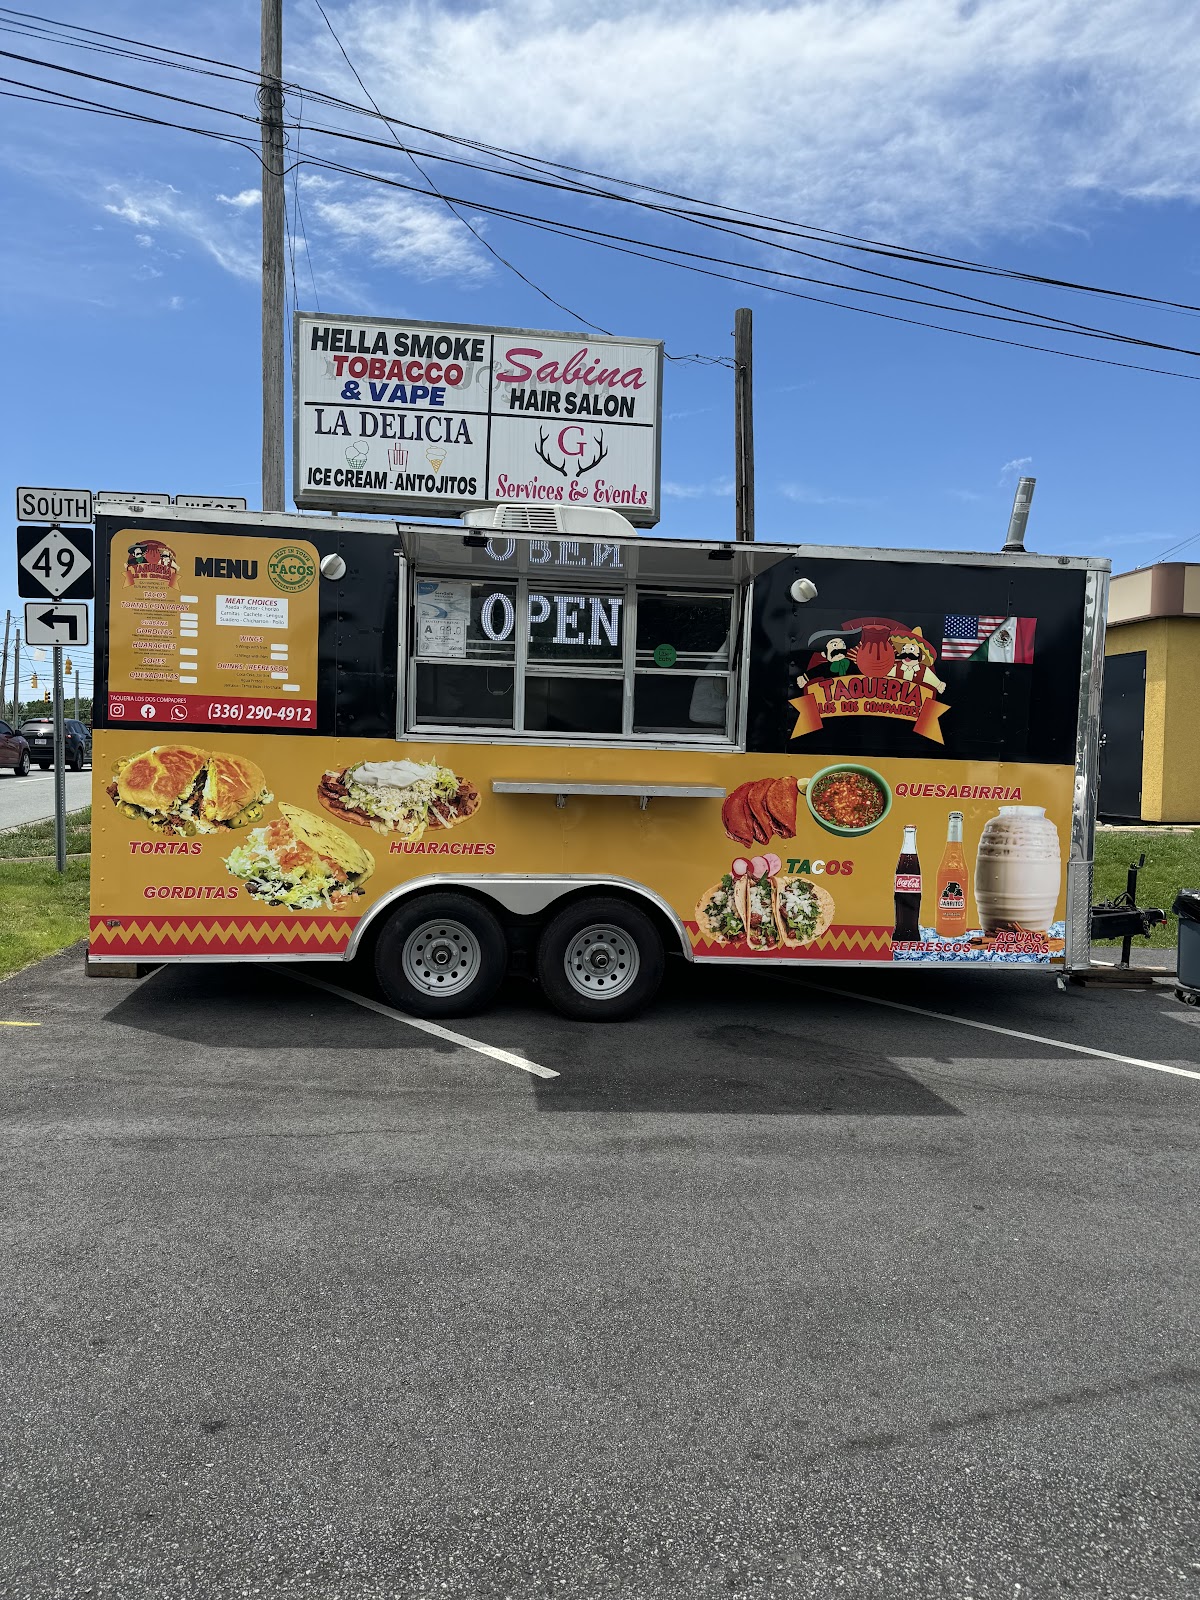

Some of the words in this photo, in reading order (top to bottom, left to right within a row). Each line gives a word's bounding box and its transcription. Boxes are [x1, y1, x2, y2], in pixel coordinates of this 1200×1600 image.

[311, 327, 389, 356] HELLA
[393, 333, 485, 362] SMOKE
[334, 355, 464, 386] TOBACCO
[496, 348, 646, 390] Sabina
[341, 380, 362, 400] &
[369, 382, 446, 406] VAPE
[510, 388, 561, 414] HAIR
[564, 392, 636, 418] SALON
[314, 409, 350, 436] LA
[360, 412, 473, 444] DELICIA
[558, 426, 587, 456] G
[308, 468, 332, 486] ICE
[334, 469, 387, 490] CREAM
[394, 472, 477, 496] ANTOJITOS
[496, 474, 563, 500] Services
[568, 480, 588, 501] &
[593, 480, 648, 505] Events
[22, 494, 86, 518] SOUTH
[32, 548, 74, 578] 49
[274, 550, 286, 560] BEST
[195, 557, 258, 580] MENU
[270, 563, 314, 576] TACOS
[424, 625, 432, 633] A
[481, 592, 622, 646] OPEN
[818, 677, 923, 707] TAQUERIA
[207, 702, 244, 721] (336)
[246, 705, 312, 721] 290-4912
[818, 702, 836, 714] LOS
[841, 701, 859, 713] DOS
[864, 701, 920, 717] COMPADRES
[895, 783, 1022, 801] QUESABIRRIA
[129, 841, 203, 855] TORTAS
[389, 841, 496, 856] HUARACHES
[785, 858, 854, 875] TACOS
[143, 886, 239, 899] GORDITAS
[889, 941, 971, 952] REFRESCOS
[987, 943, 1049, 954] FRESCAS
[995, 931, 1042, 943] AGUAS
